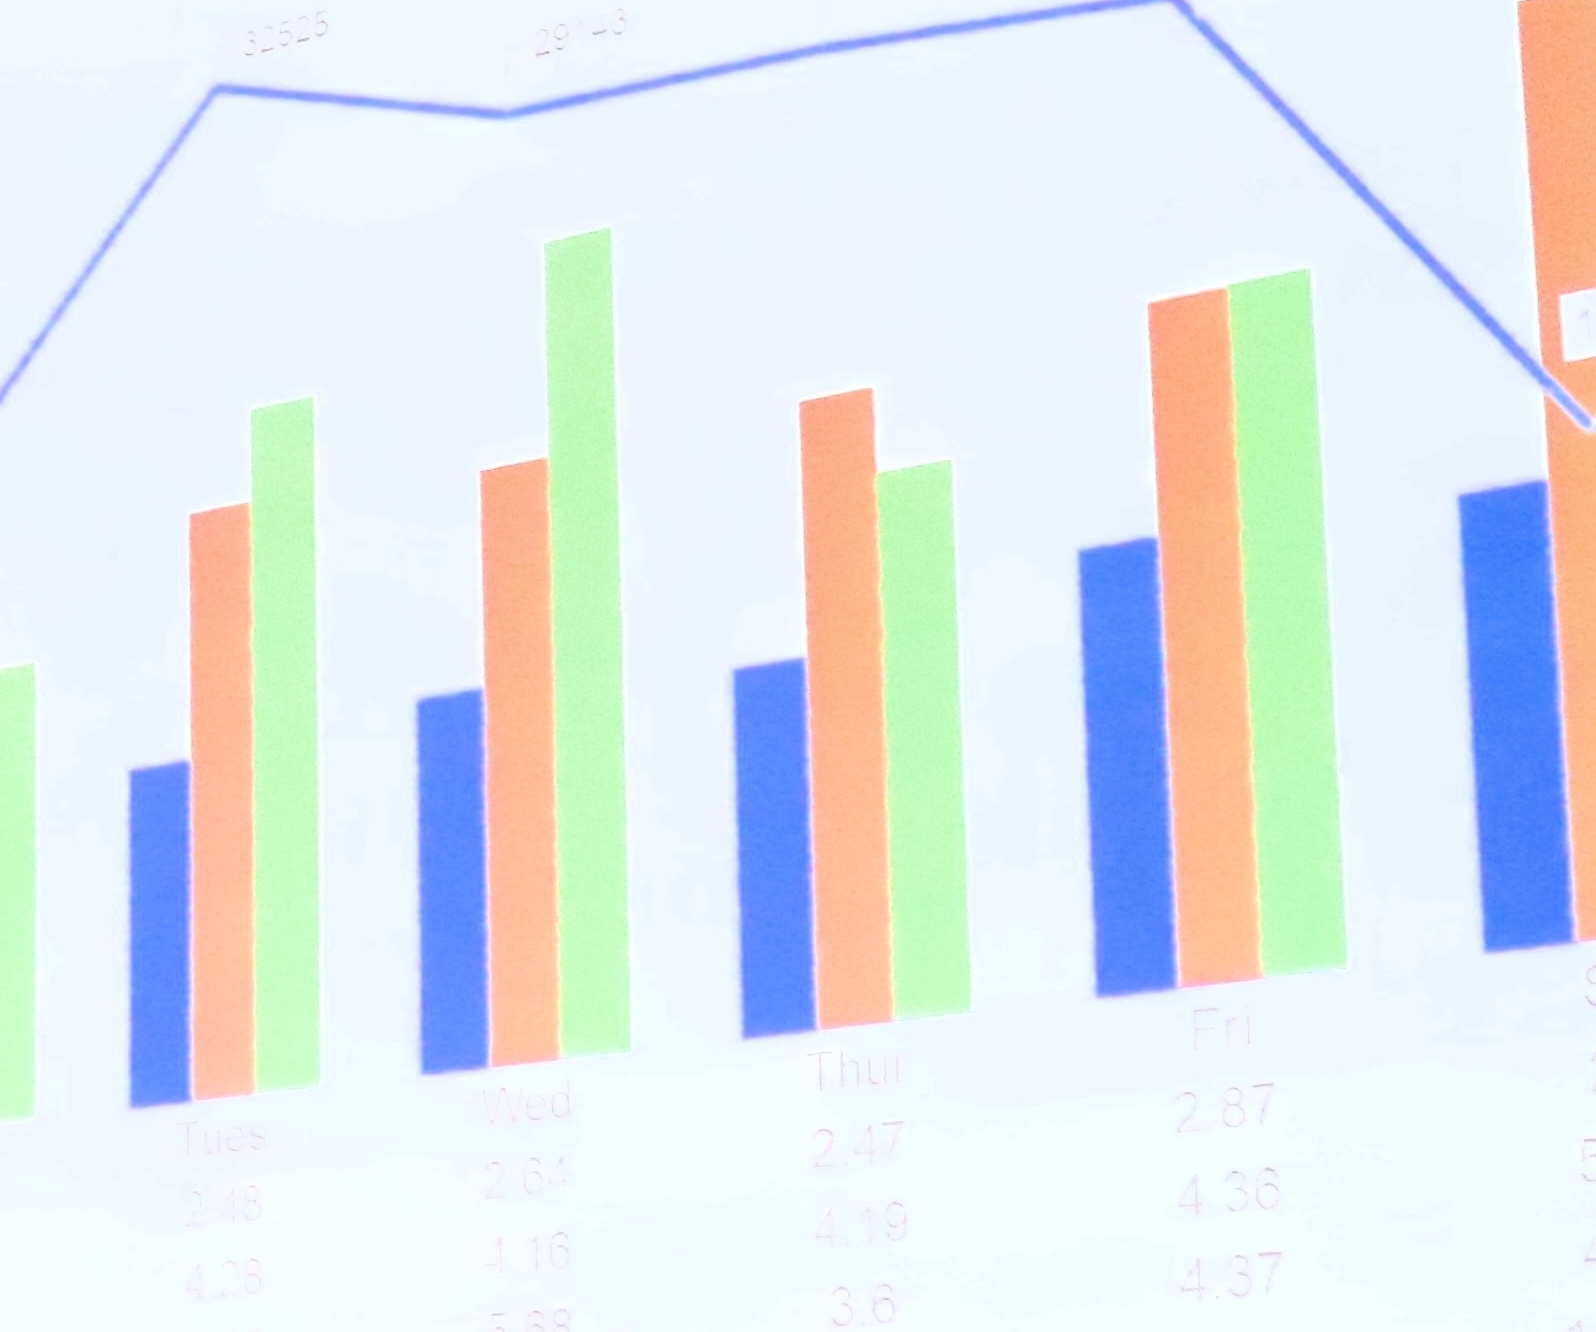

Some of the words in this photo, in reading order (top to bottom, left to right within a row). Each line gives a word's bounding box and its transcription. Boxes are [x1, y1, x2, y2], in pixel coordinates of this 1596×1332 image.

[241, 8, 331, 60] 32525
[177, 1119, 268, 1158] Tues
[481, 1081, 573, 1127] Wed
[808, 1050, 906, 1092] Thur
[1189, 1003, 1254, 1052] Fri
[183, 1184, 265, 1229] 248
[483, 1154, 571, 1202] 264
[810, 1118, 906, 1170] 2.47
[484, 1228, 572, 1274] 416
[829, 1281, 899, 1328] 3.6
[1178, 1249, 1285, 1301] 4.37
